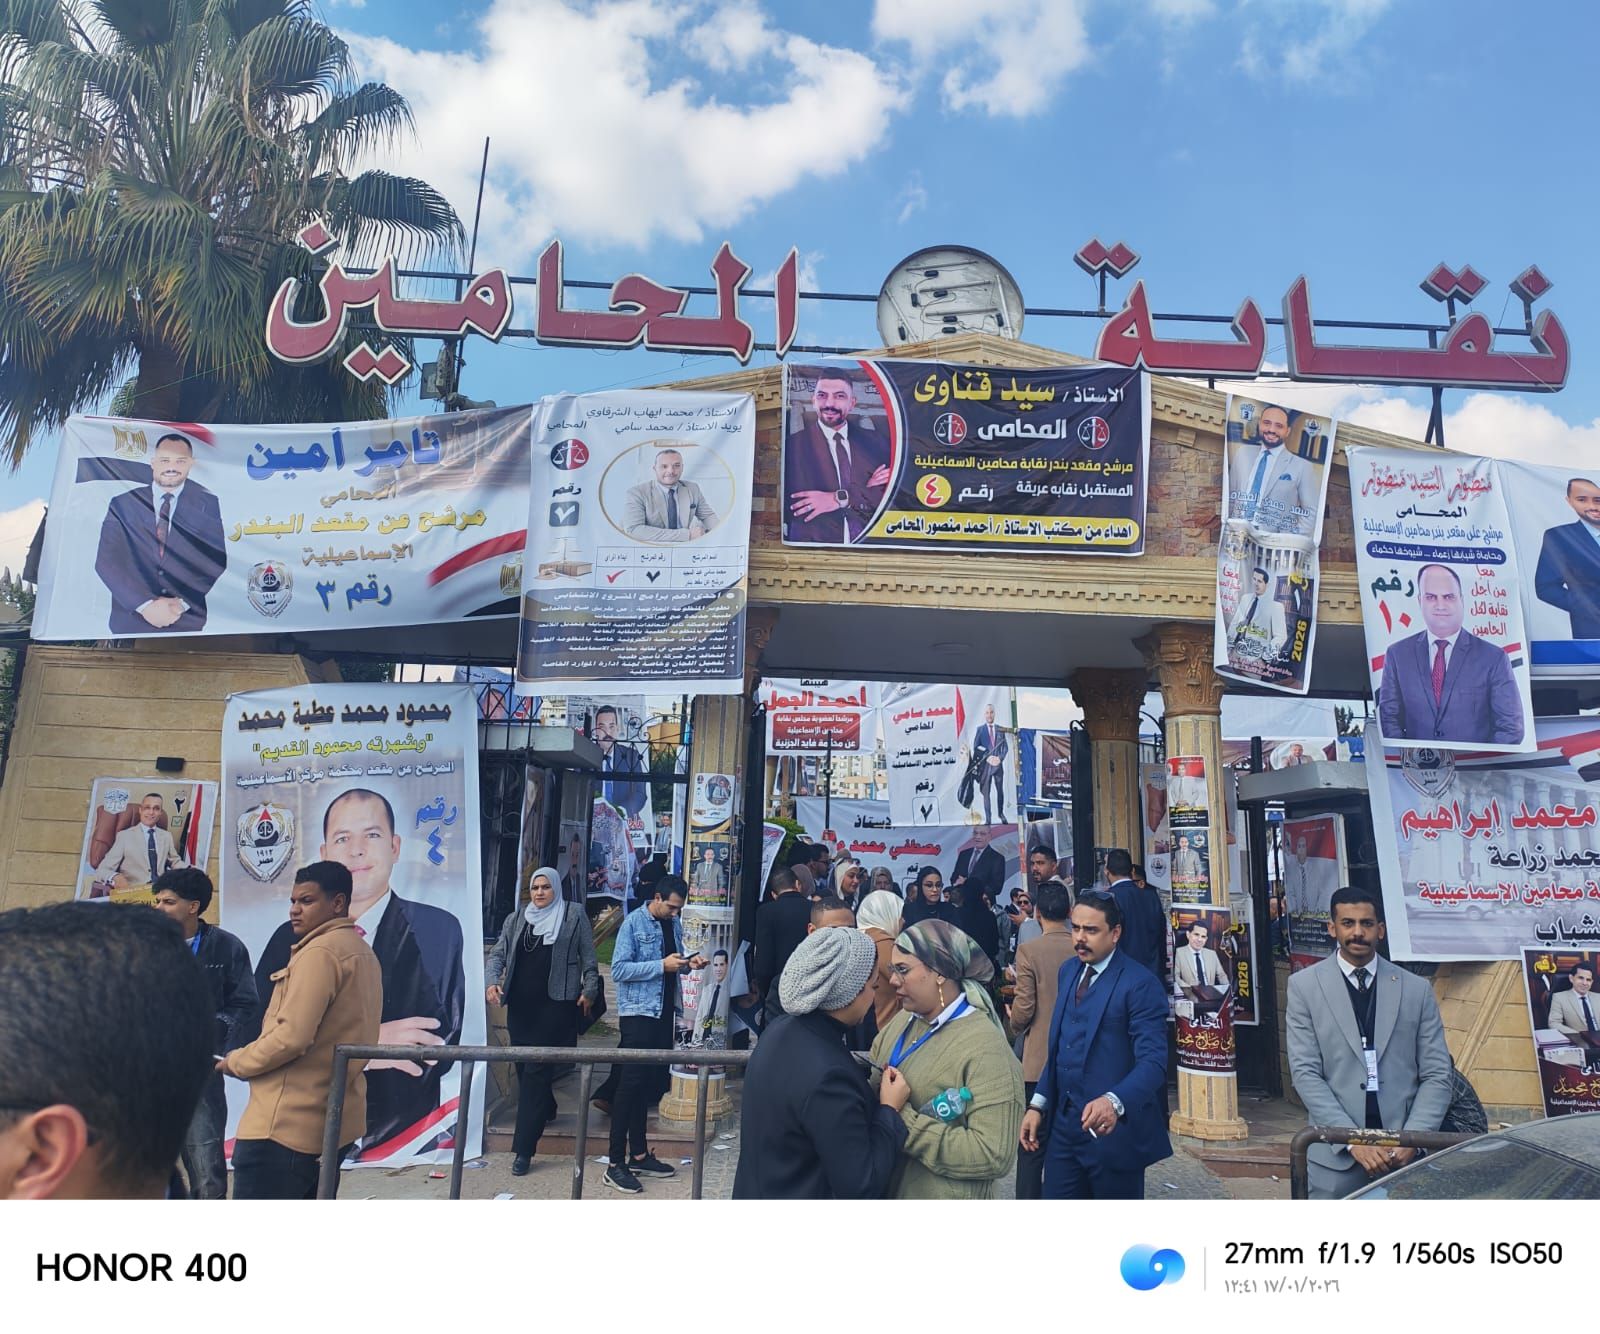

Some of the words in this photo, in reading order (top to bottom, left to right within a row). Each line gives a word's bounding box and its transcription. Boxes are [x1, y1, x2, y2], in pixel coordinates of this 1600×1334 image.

[266, 219, 799, 384] المحامين
[914, 372, 993, 407] قناوى
[1000, 376, 1056, 410] سيد
[1074, 386, 1125, 404] الاستاذ
[705, 408, 737, 417] الاستاذ
[547, 419, 588, 431] المحامي
[645, 424, 673, 432] محمد
[686, 421, 717, 432] الاستاذ
[976, 418, 1068, 441] المحامى
[245, 425, 346, 482] أمين
[351, 426, 443, 479] تامر
[914, 454, 976, 471] الاسماعيلية
[977, 456, 1018, 472] محامين
[1020, 455, 1048, 472] نقابة
[1049, 456, 1069, 472] بندر
[1070, 457, 1101, 472] مقعد
[1103, 458, 1134, 477] مرشح
[319, 483, 398, 509] المحامي
[552, 482, 582, 498] رقم
[924, 475, 944, 506] ٤
[958, 484, 994, 502] رقم
[1016, 480, 1049, 497] عريقة
[1080, 483, 1134, 500] المستقبل
[417, 504, 487, 533] مرشح
[1396, 503, 1468, 519] المحامى
[229, 512, 304, 542] البندر
[311, 512, 370, 534] مقعد
[377, 513, 411, 535] عن
[926, 520, 961, 537] منصور
[963, 516, 995, 535] أحمد
[1004, 518, 1042, 536] الاستاذ
[1044, 521, 1083, 540] مكتب
[1104, 523, 1132, 540] اهداء
[1085, 526, 1103, 541] من
[345, 573, 393, 611] رقم
[1370, 568, 1415, 600] رقم
[315, 580, 336, 612] ٣
[1378, 599, 1413, 635] ١٠
[1488, 601, 1509, 618] نقابة
[1291, 619, 1308, 662] 2026
[763, 690, 814, 711] الجمل
[238, 709, 287, 732] محمد
[292, 698, 335, 732] عطية
[340, 703, 390, 724] محمد
[396, 701, 452, 727] محمود
[893, 707, 923, 724] سامي
[926, 706, 954, 717] محمد
[312, 740, 362, 758] محمود
[844, 740, 856, 749] عن
[298, 766, 325, 785] مركز
[327, 761, 363, 778] محكمة
[366, 763, 394, 776] مقعد
[397, 764, 412, 777] عن
[414, 759, 455, 777] المرشح
[915, 779, 935, 795] رقم
[415, 797, 459, 830] رقم
[920, 803, 933, 824] ٧
[1400, 796, 1504, 841] إبراهيم
[1511, 800, 1599, 830] محمد
[425, 826, 446, 866] ٤
[1488, 846, 1547, 873] زراعة
[1523, 881, 1584, 907] محامين
[1238, 961, 1250, 997] 2026
